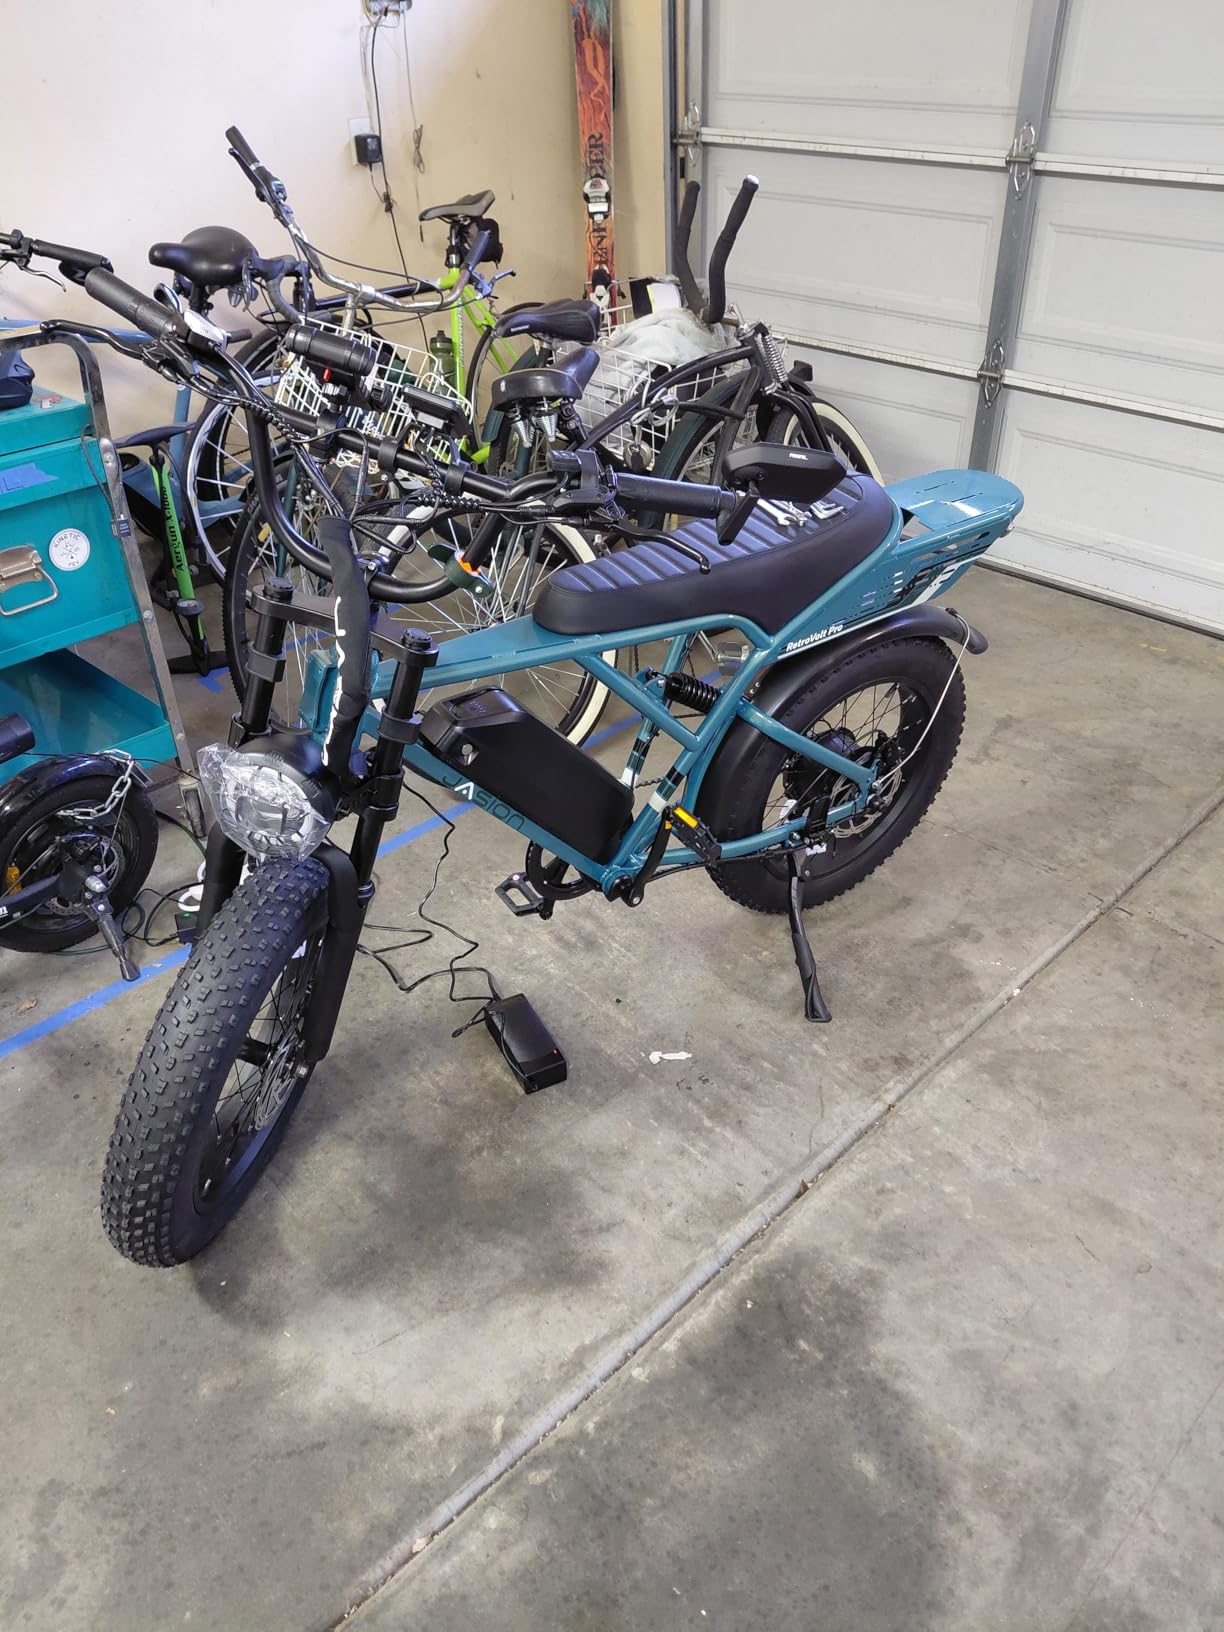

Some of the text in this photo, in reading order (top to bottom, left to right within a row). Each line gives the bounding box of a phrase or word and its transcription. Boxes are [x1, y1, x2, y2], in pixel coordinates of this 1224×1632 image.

[54, 532, 81, 548] KINETIC
[786, 624, 844, 652] RetroVolt Pro
